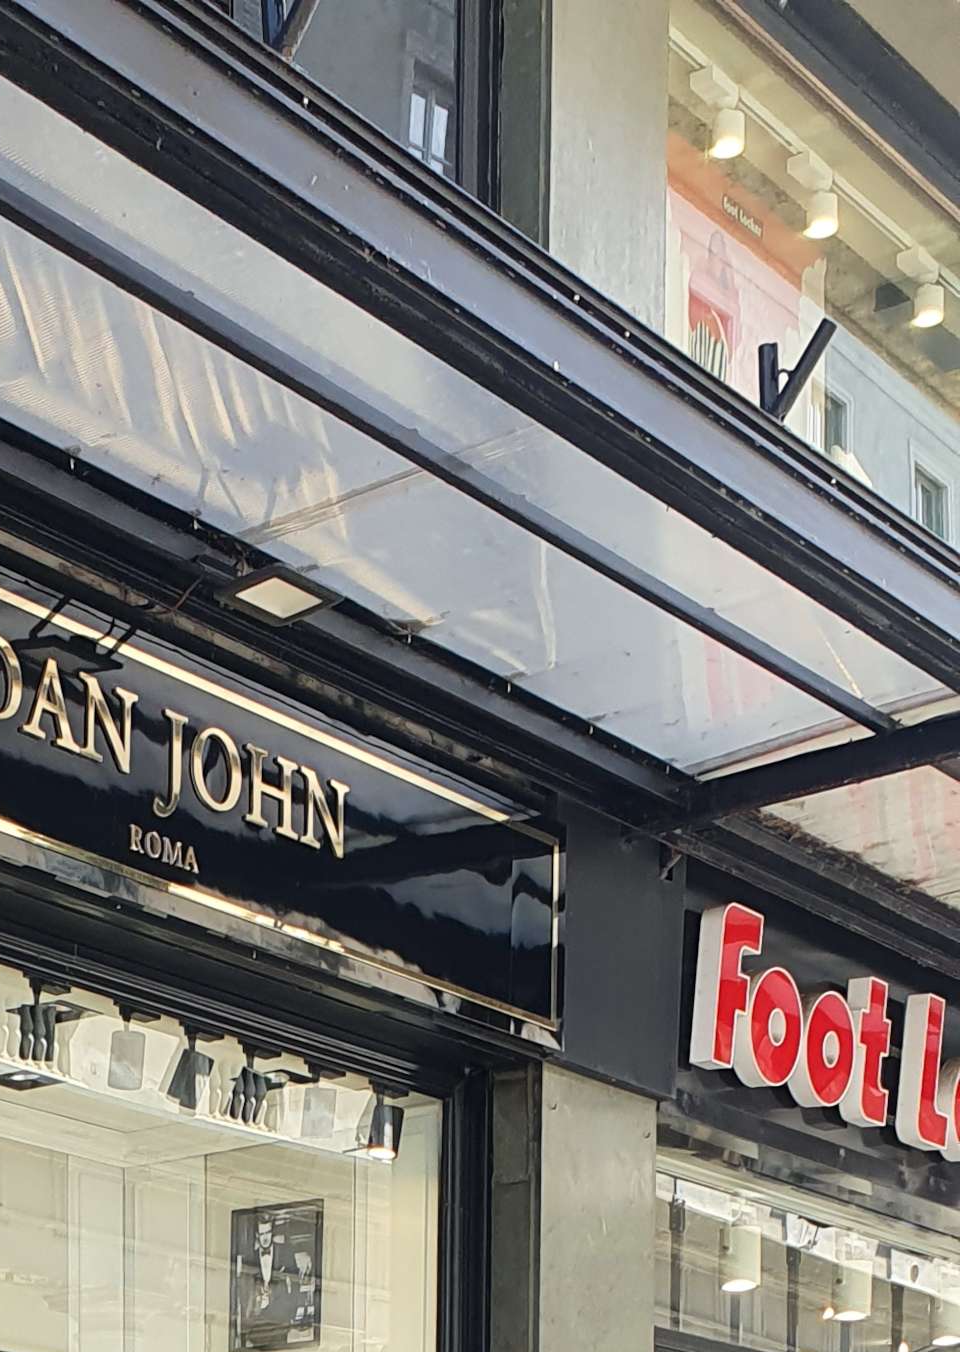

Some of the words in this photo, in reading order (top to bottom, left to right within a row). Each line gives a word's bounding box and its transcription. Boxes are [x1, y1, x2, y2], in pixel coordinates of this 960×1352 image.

[129, 823, 200, 874] ROMA
[152, 708, 350, 858] JOHN
[690, 902, 891, 1127] Foot
[895, 993, 960, 1161] L
